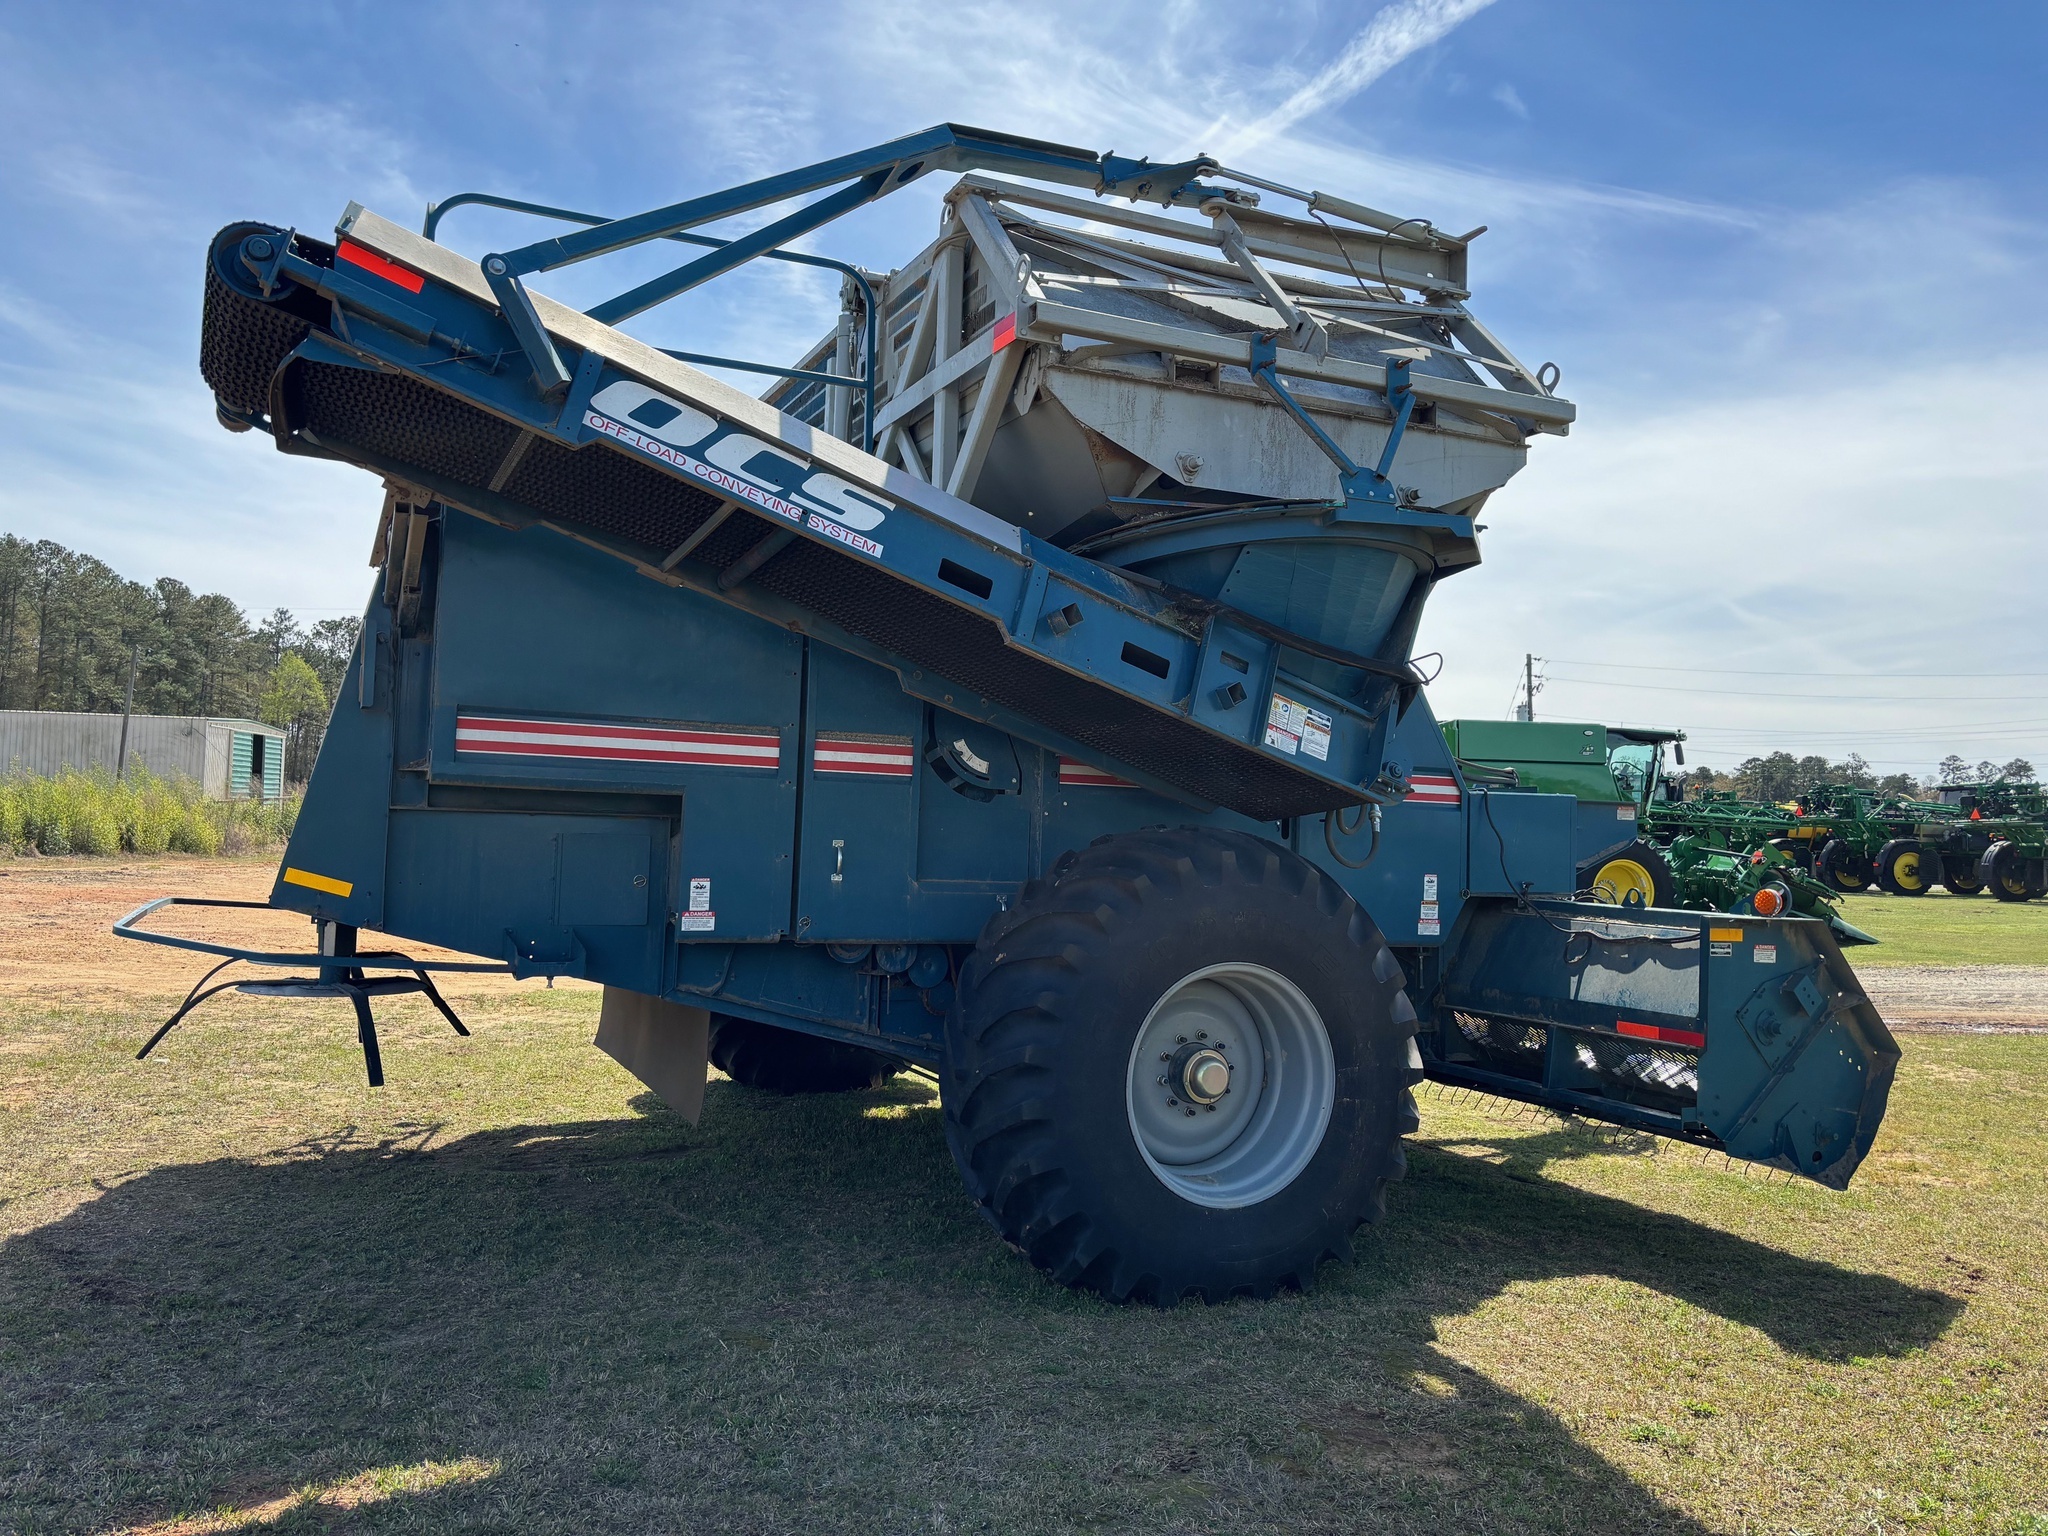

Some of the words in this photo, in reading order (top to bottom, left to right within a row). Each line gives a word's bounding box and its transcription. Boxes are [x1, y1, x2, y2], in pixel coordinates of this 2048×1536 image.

[589, 380, 897, 532] OCS
[589, 414, 687, 467] OFF-LOAD
[693, 463, 802, 520] CONVEYING
[808, 515, 877, 555] SYSTEM
